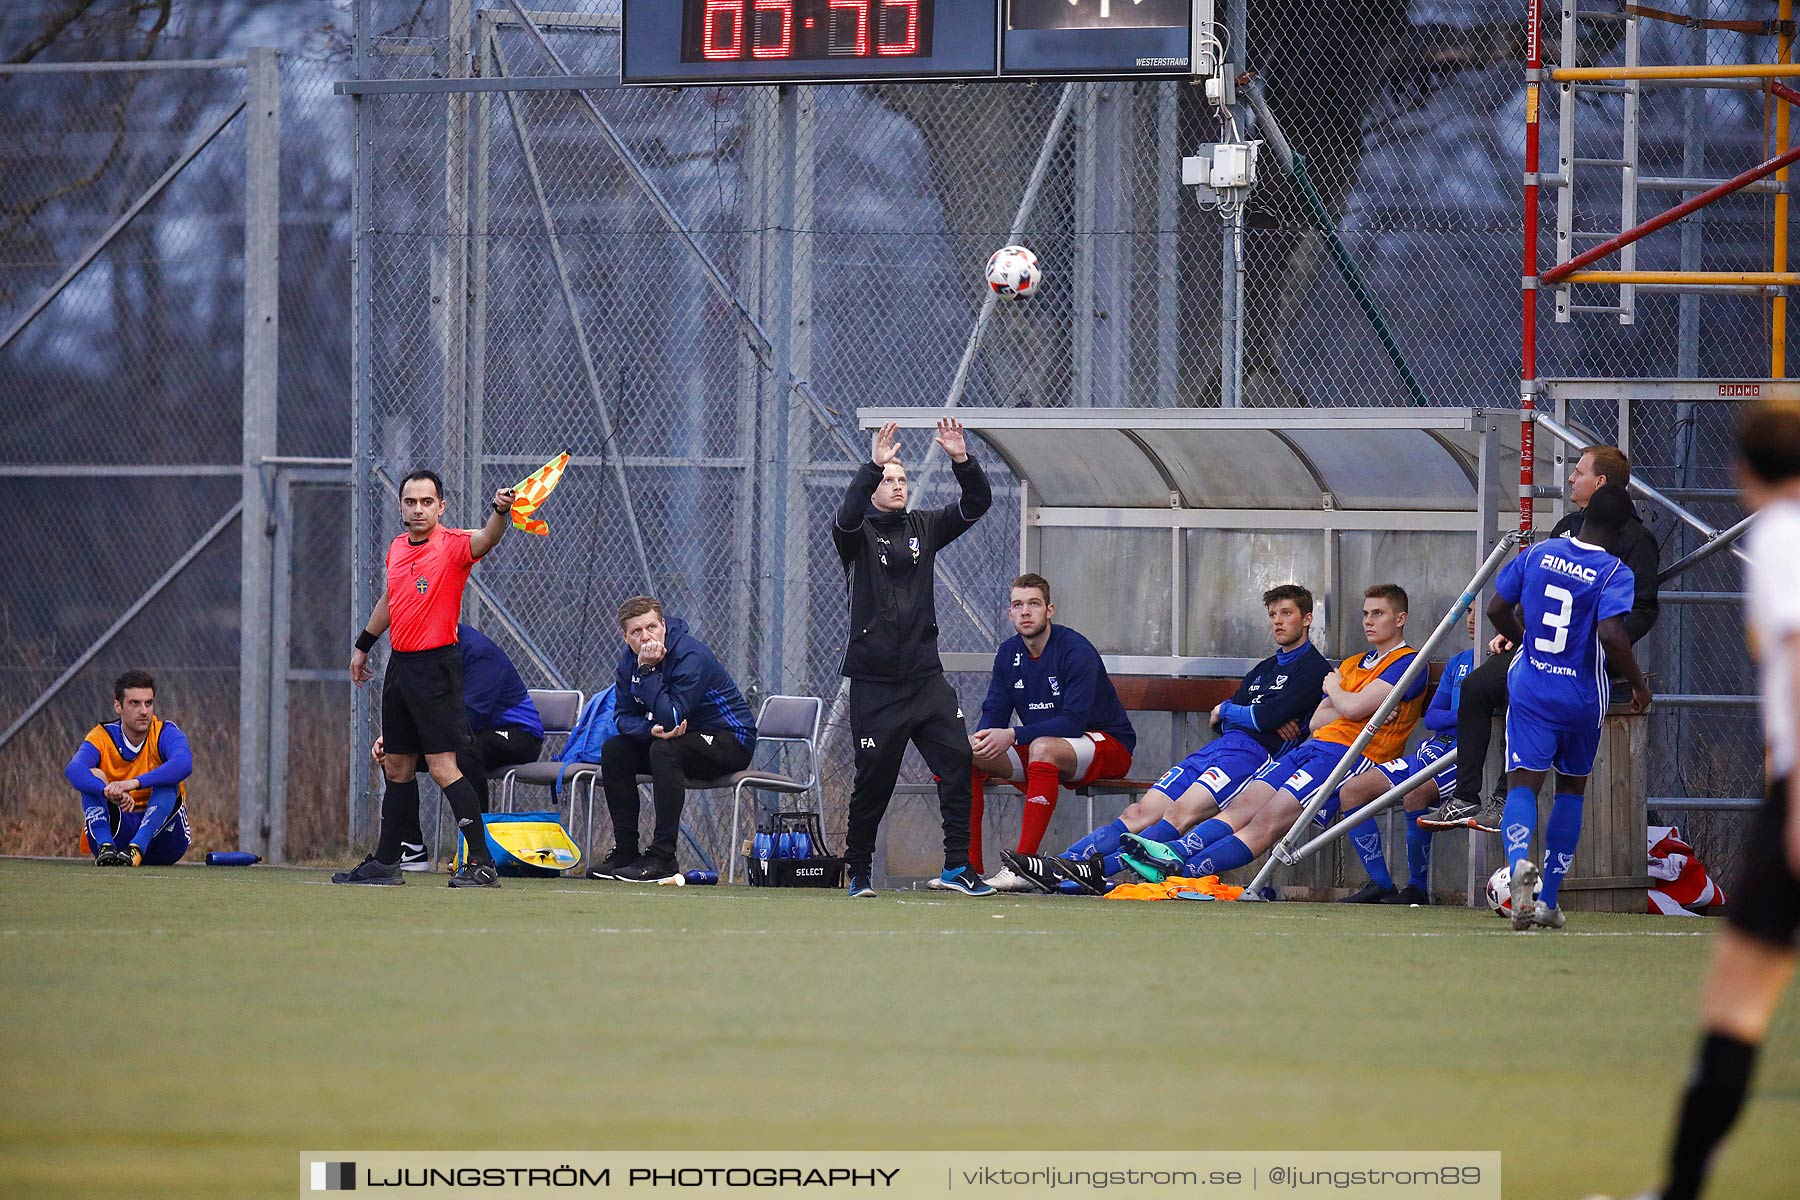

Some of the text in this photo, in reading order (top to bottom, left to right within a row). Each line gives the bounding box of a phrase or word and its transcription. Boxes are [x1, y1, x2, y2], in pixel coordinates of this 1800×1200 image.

[1135, 57, 1189, 67] WESTERSTRAND
[1719, 386, 1759, 395] CRAMO
[1534, 583, 1574, 655] 3
[1552, 665, 1577, 678] EXTRA
[1028, 701, 1055, 710] stadium
[860, 737, 876, 749] FA
[795, 866, 825, 877] SELECT
